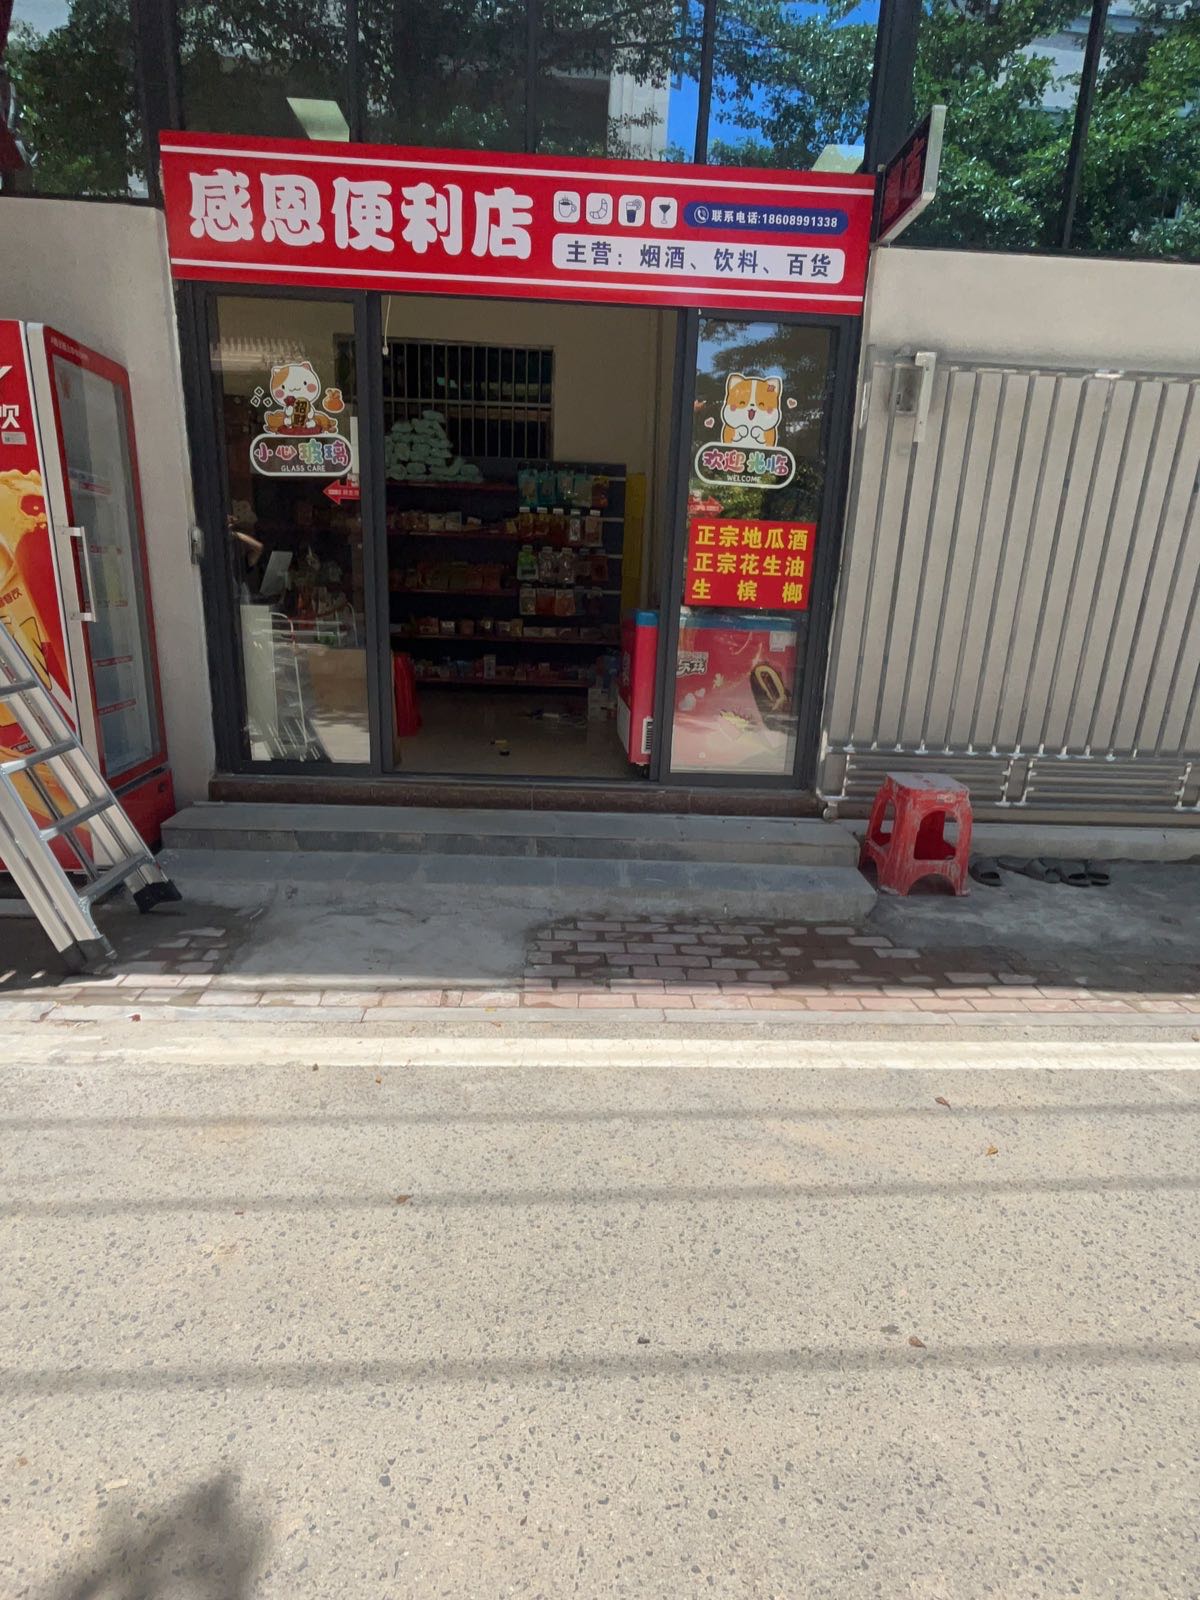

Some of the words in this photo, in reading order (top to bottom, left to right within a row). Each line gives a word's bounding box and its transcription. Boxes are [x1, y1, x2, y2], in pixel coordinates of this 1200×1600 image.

[189, 168, 534, 260] 感恩便利店
[253, 438, 349, 466] 小心玻璃
[702, 448, 790, 477] 欢迎光临
[280, 465, 305, 473] GLASS
[307, 465, 326, 473] CARE
[726, 473, 762, 483] WELCOME
[695, 524, 809, 551] 正宗地瓜酒
[693, 552, 806, 578] 正宗花生油
